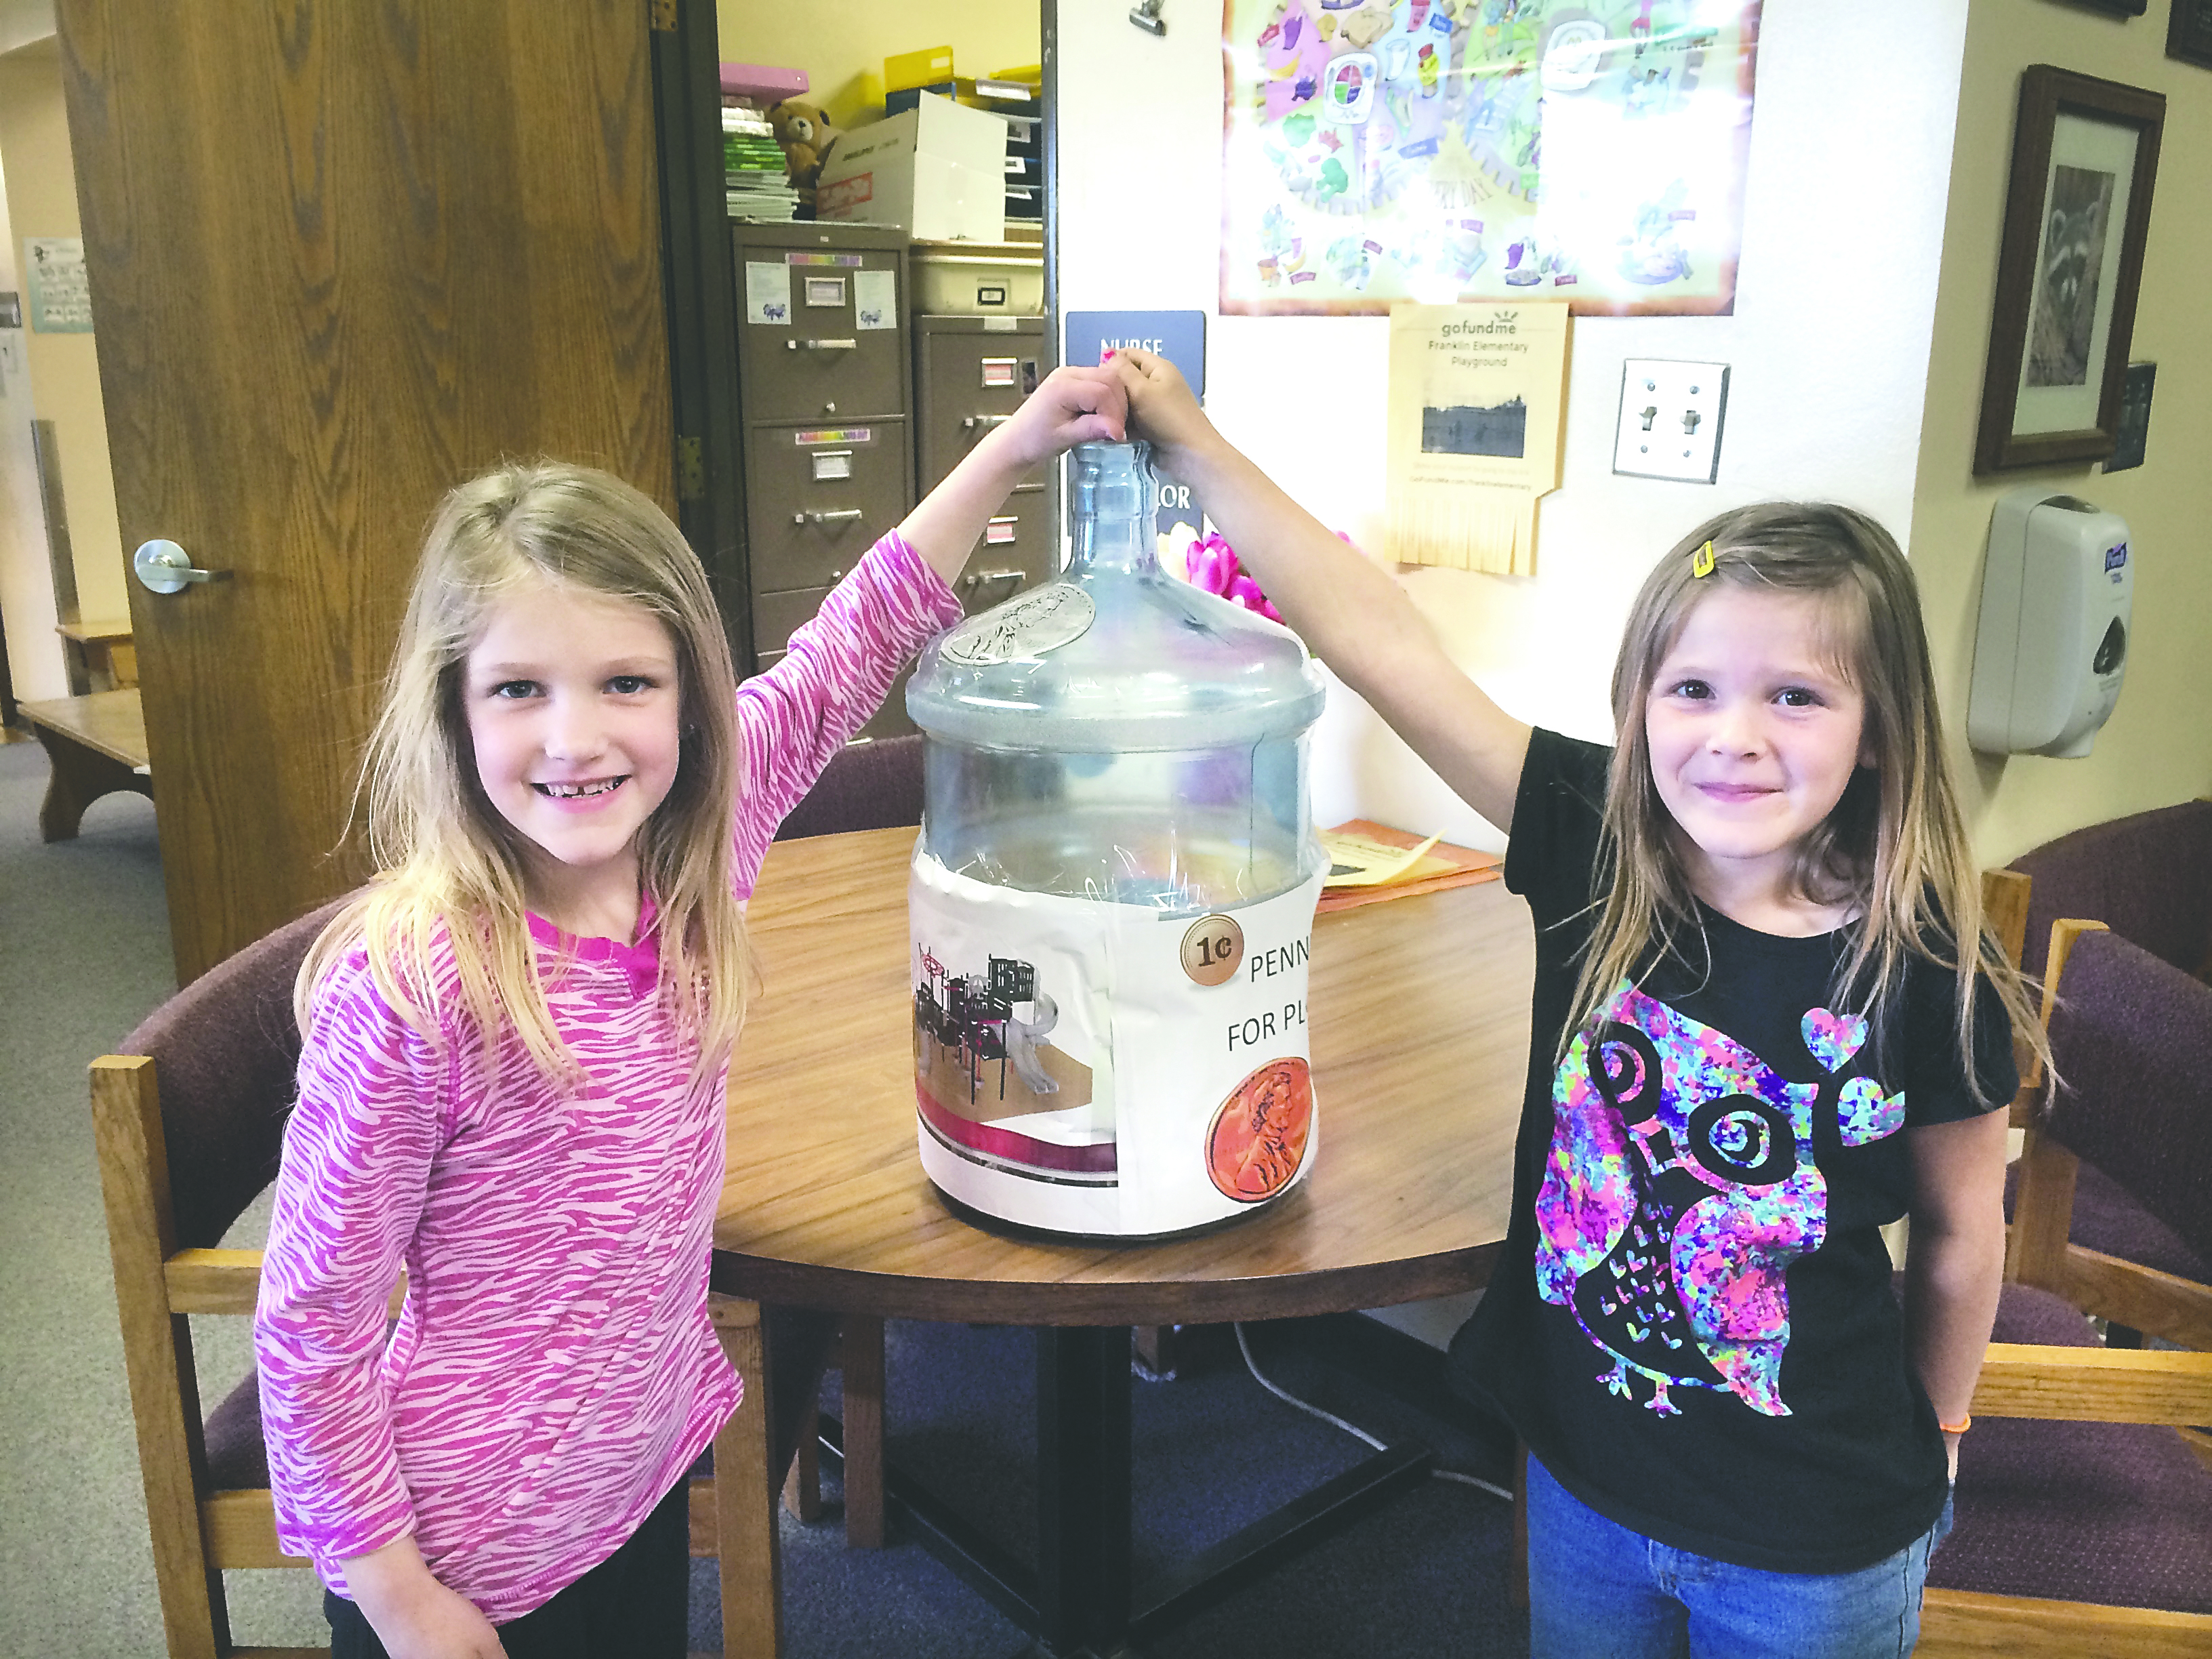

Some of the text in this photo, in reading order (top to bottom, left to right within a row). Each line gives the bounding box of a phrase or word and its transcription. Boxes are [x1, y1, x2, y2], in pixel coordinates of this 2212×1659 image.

[1441, 320, 1517, 337] gofundme
[1428, 340, 1529, 354] Franklin Elementary
[1452, 356, 1508, 369] Playground
[1158, 484, 1191, 510] OR
[1252, 935, 1311, 983] PENN
[1229, 1000, 1308, 1051] FOR PL
